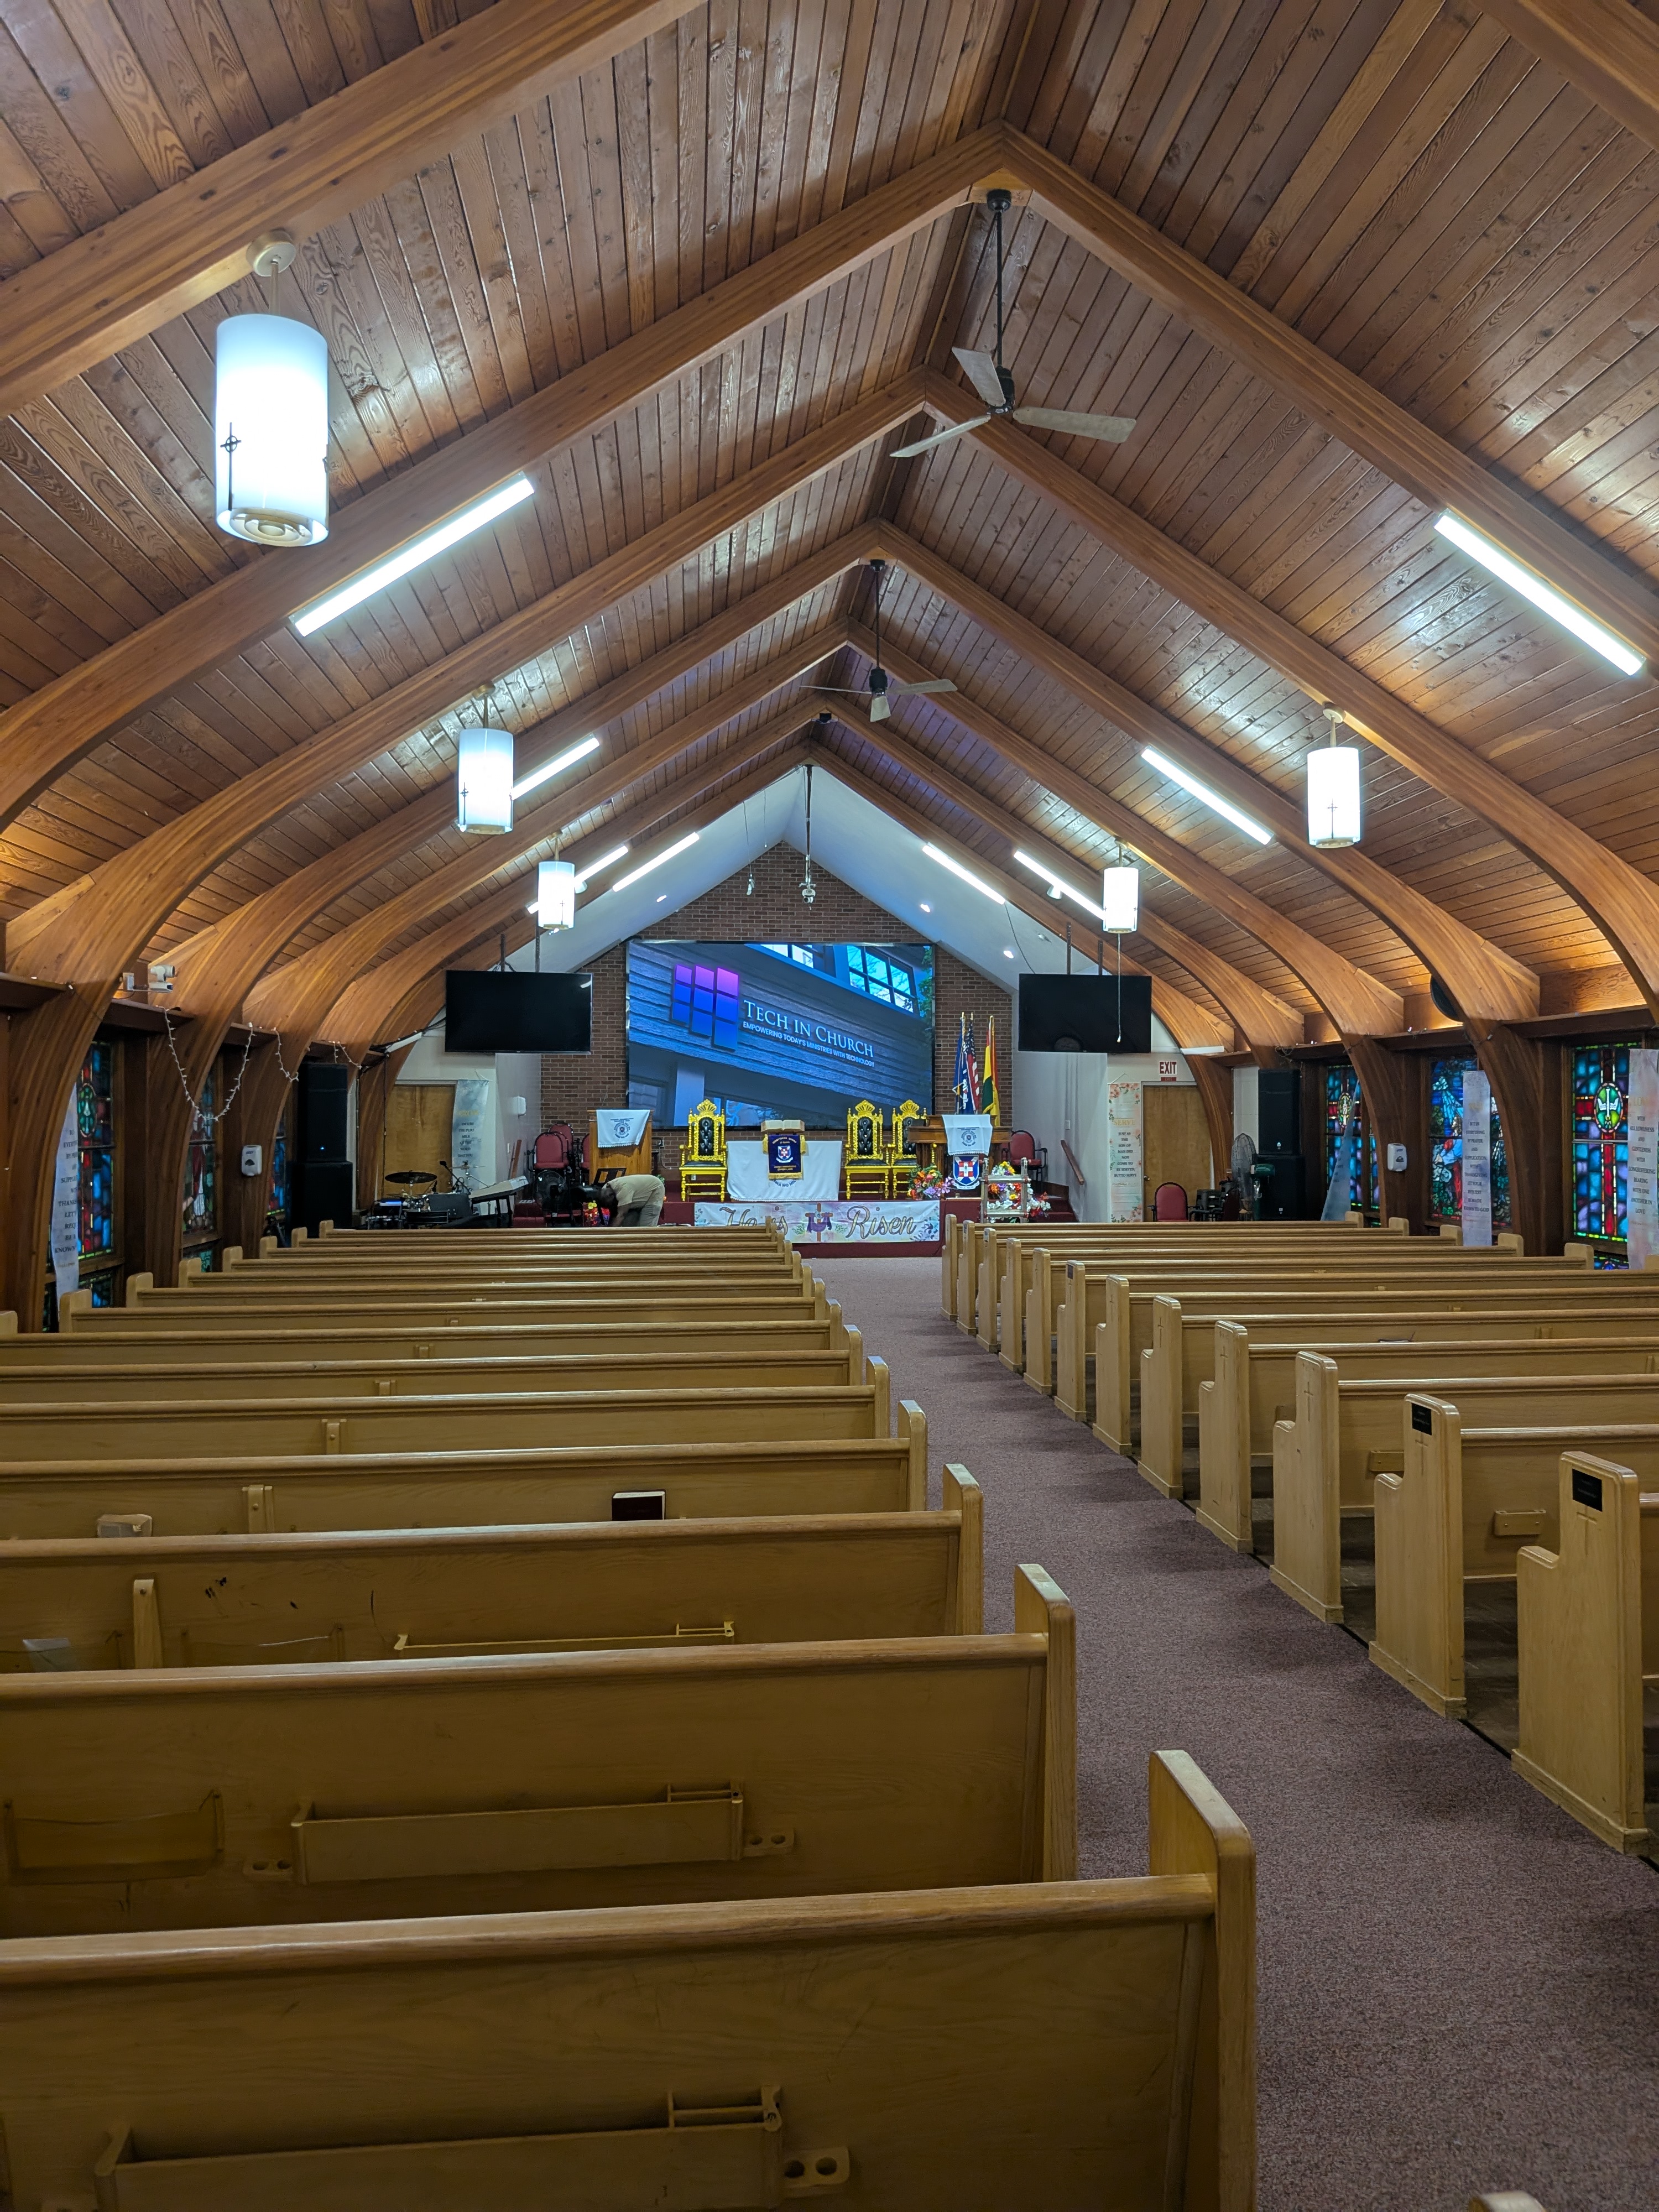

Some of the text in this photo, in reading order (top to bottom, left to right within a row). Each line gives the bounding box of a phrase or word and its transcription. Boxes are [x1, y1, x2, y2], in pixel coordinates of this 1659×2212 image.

[743, 1021, 875, 1067] EMPOWERING TODAY'S MINISTRIES WITH TECHNOLOGY
[1160, 1061, 1177, 1074] EXIT
[844, 1206, 917, 1240] Risen
